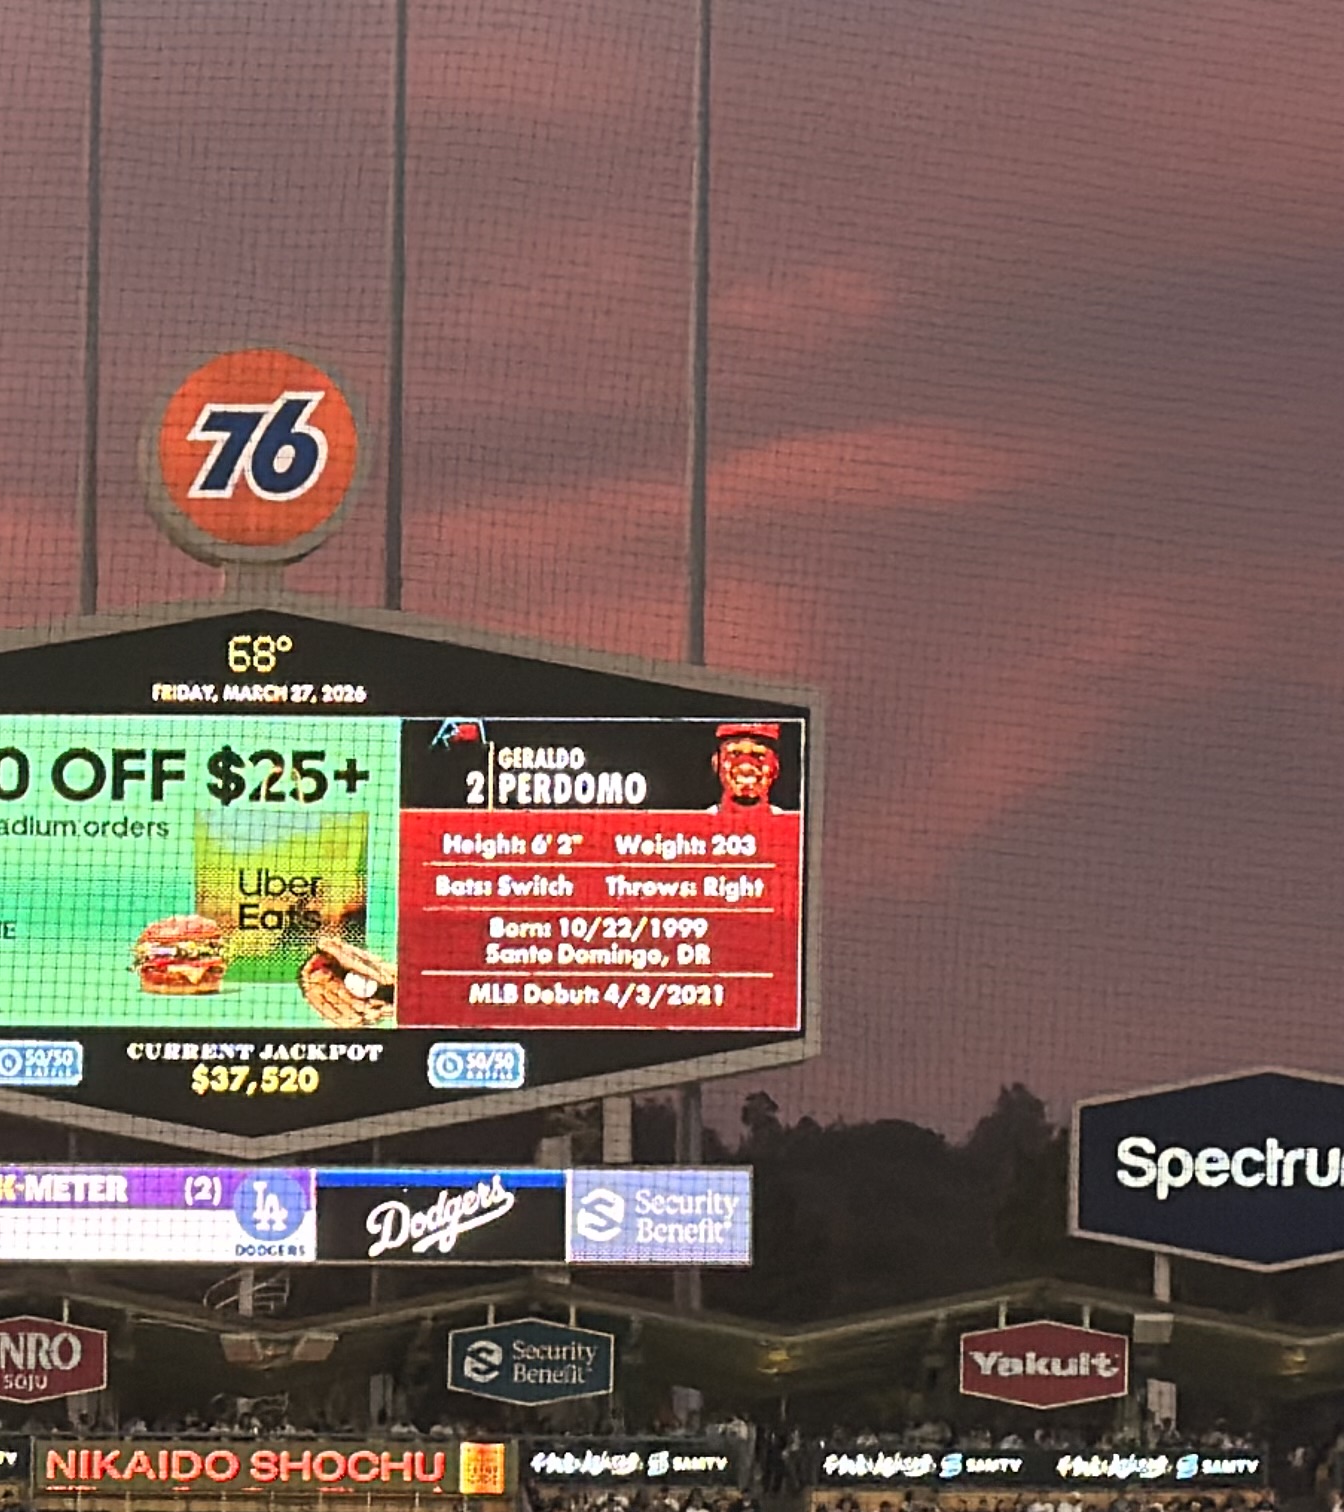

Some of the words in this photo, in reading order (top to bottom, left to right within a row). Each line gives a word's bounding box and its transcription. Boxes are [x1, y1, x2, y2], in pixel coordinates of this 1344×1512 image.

[186, 390, 330, 501] 76
[152, 684, 218, 703] FRIDAY,
[223, 684, 288, 702] MARCH
[291, 684, 316, 704] 27,
[322, 684, 367, 703] 2026
[498, 747, 585, 769] GERALDO
[52, 746, 186, 802] OFF
[207, 745, 370, 806] $25+
[467, 771, 484, 804] 2
[499, 773, 647, 804] PERDOMO
[83, 817, 169, 838] orders
[443, 834, 526, 859] Height:
[531, 834, 553, 855] 6'
[615, 834, 706, 859] Weight:
[712, 834, 756, 856] 203
[239, 868, 321, 897] Uber
[435, 876, 492, 897] Bats:
[497, 876, 573, 897] Switch
[606, 876, 697, 898] Throws:
[703, 876, 764, 901] Right
[239, 904, 322, 931] Eats
[489, 917, 551, 938] Born:
[559, 917, 708, 942] 10/22/1999
[486, 944, 553, 965] Santo
[557, 944, 669, 969] Domingo,
[677, 944, 710, 965] DR
[469, 984, 518, 1003] MLB
[524, 984, 599, 1004] Debut:
[603, 984, 724, 1008] 4/3/2021
[25, 1048, 74, 1067] 50/50
[127, 1043, 251, 1062] CURRENT
[259, 1043, 383, 1062] JACKPOT
[466, 1051, 515, 1070] 50/50
[191, 1064, 319, 1096] $37,520
[1116, 1137, 1344, 1200] Spectru
[184, 1176, 223, 1206] (2)
[635, 1188, 739, 1219] Security
[367, 1174, 515, 1257] Dodgers
[638, 1218, 726, 1244] Benefit
[235, 1244, 306, 1257] DODGERS
[512, 1339, 598, 1365] Security
[969, 1350, 1120, 1378] Yakult
[3, 1373, 48, 1392] SOJU
[513, 1363, 587, 1384] Benefit
[45, 1449, 239, 1482] NIKAIDO
[249, 1449, 445, 1482] SHOCHU
